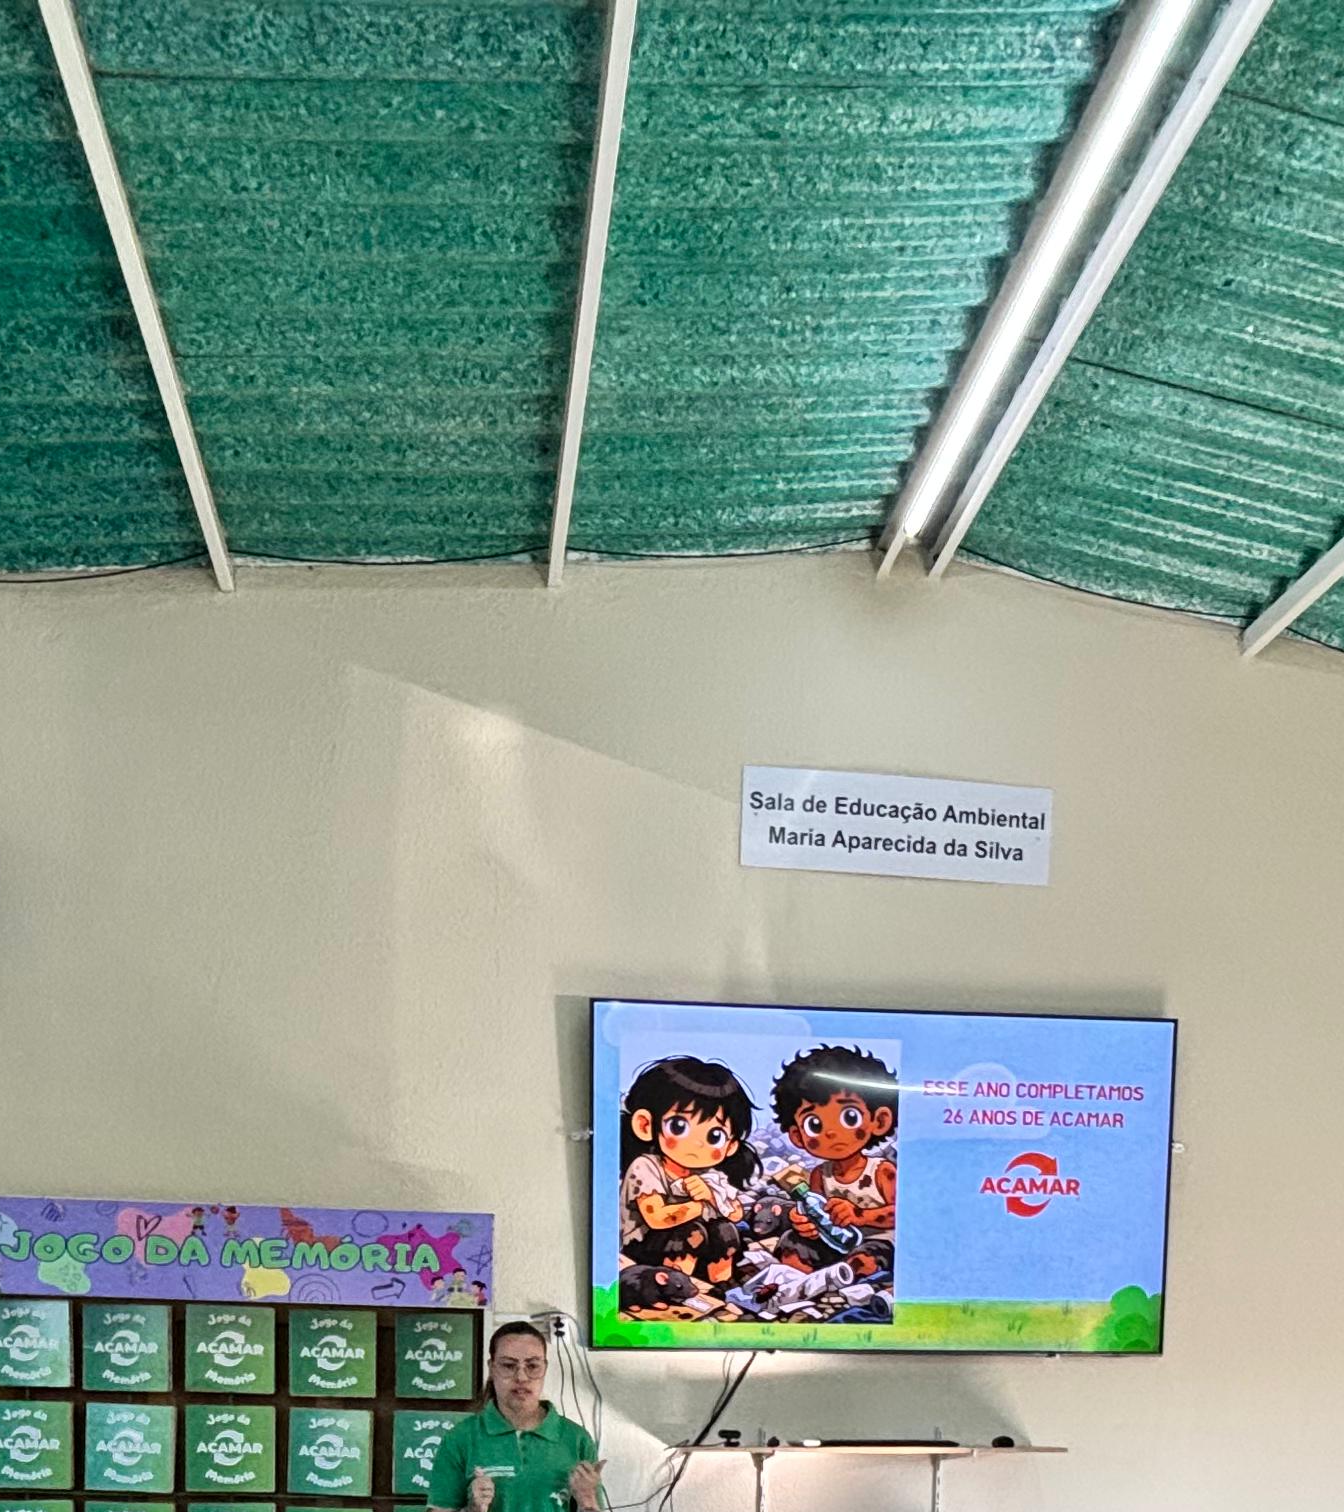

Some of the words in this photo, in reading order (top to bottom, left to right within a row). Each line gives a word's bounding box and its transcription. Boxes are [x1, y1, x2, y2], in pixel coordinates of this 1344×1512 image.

[749, 791, 795, 811] Sala
[802, 794, 827, 813] de
[835, 796, 937, 824] Educação
[942, 805, 1046, 830] Ambiental
[768, 826, 825, 847] Maria
[831, 830, 936, 854] Aparecida
[943, 838, 968, 858] da
[974, 841, 1024, 861] Silva
[923, 1080, 968, 1097] ESSE
[973, 1082, 1010, 1098] ANO
[1016, 1083, 1145, 1101] COMPLETAMOS
[943, 1108, 964, 1125] 26
[968, 1109, 1016, 1126] ANOS
[1022, 1110, 1045, 1127] DE
[1049, 1112, 1125, 1129] ACAMAR
[979, 1177, 1081, 1196] ACAMAR
[143, 1236, 210, 1267] DA
[221, 1236, 441, 1275] MEMÓRIA
[94, 1342, 158, 1354] ACAMAR
[197, 1342, 264, 1356] ACAMAR
[300, 1347, 365, 1359] ACAMAR
[405, 1350, 463, 1361] ACAMAR
[96, 1440, 161, 1454] ACAMAR
[196, 1442, 263, 1454] ACAMAR
[299, 1445, 360, 1460] ACAMAR
[404, 1448, 437, 1458] ACA
